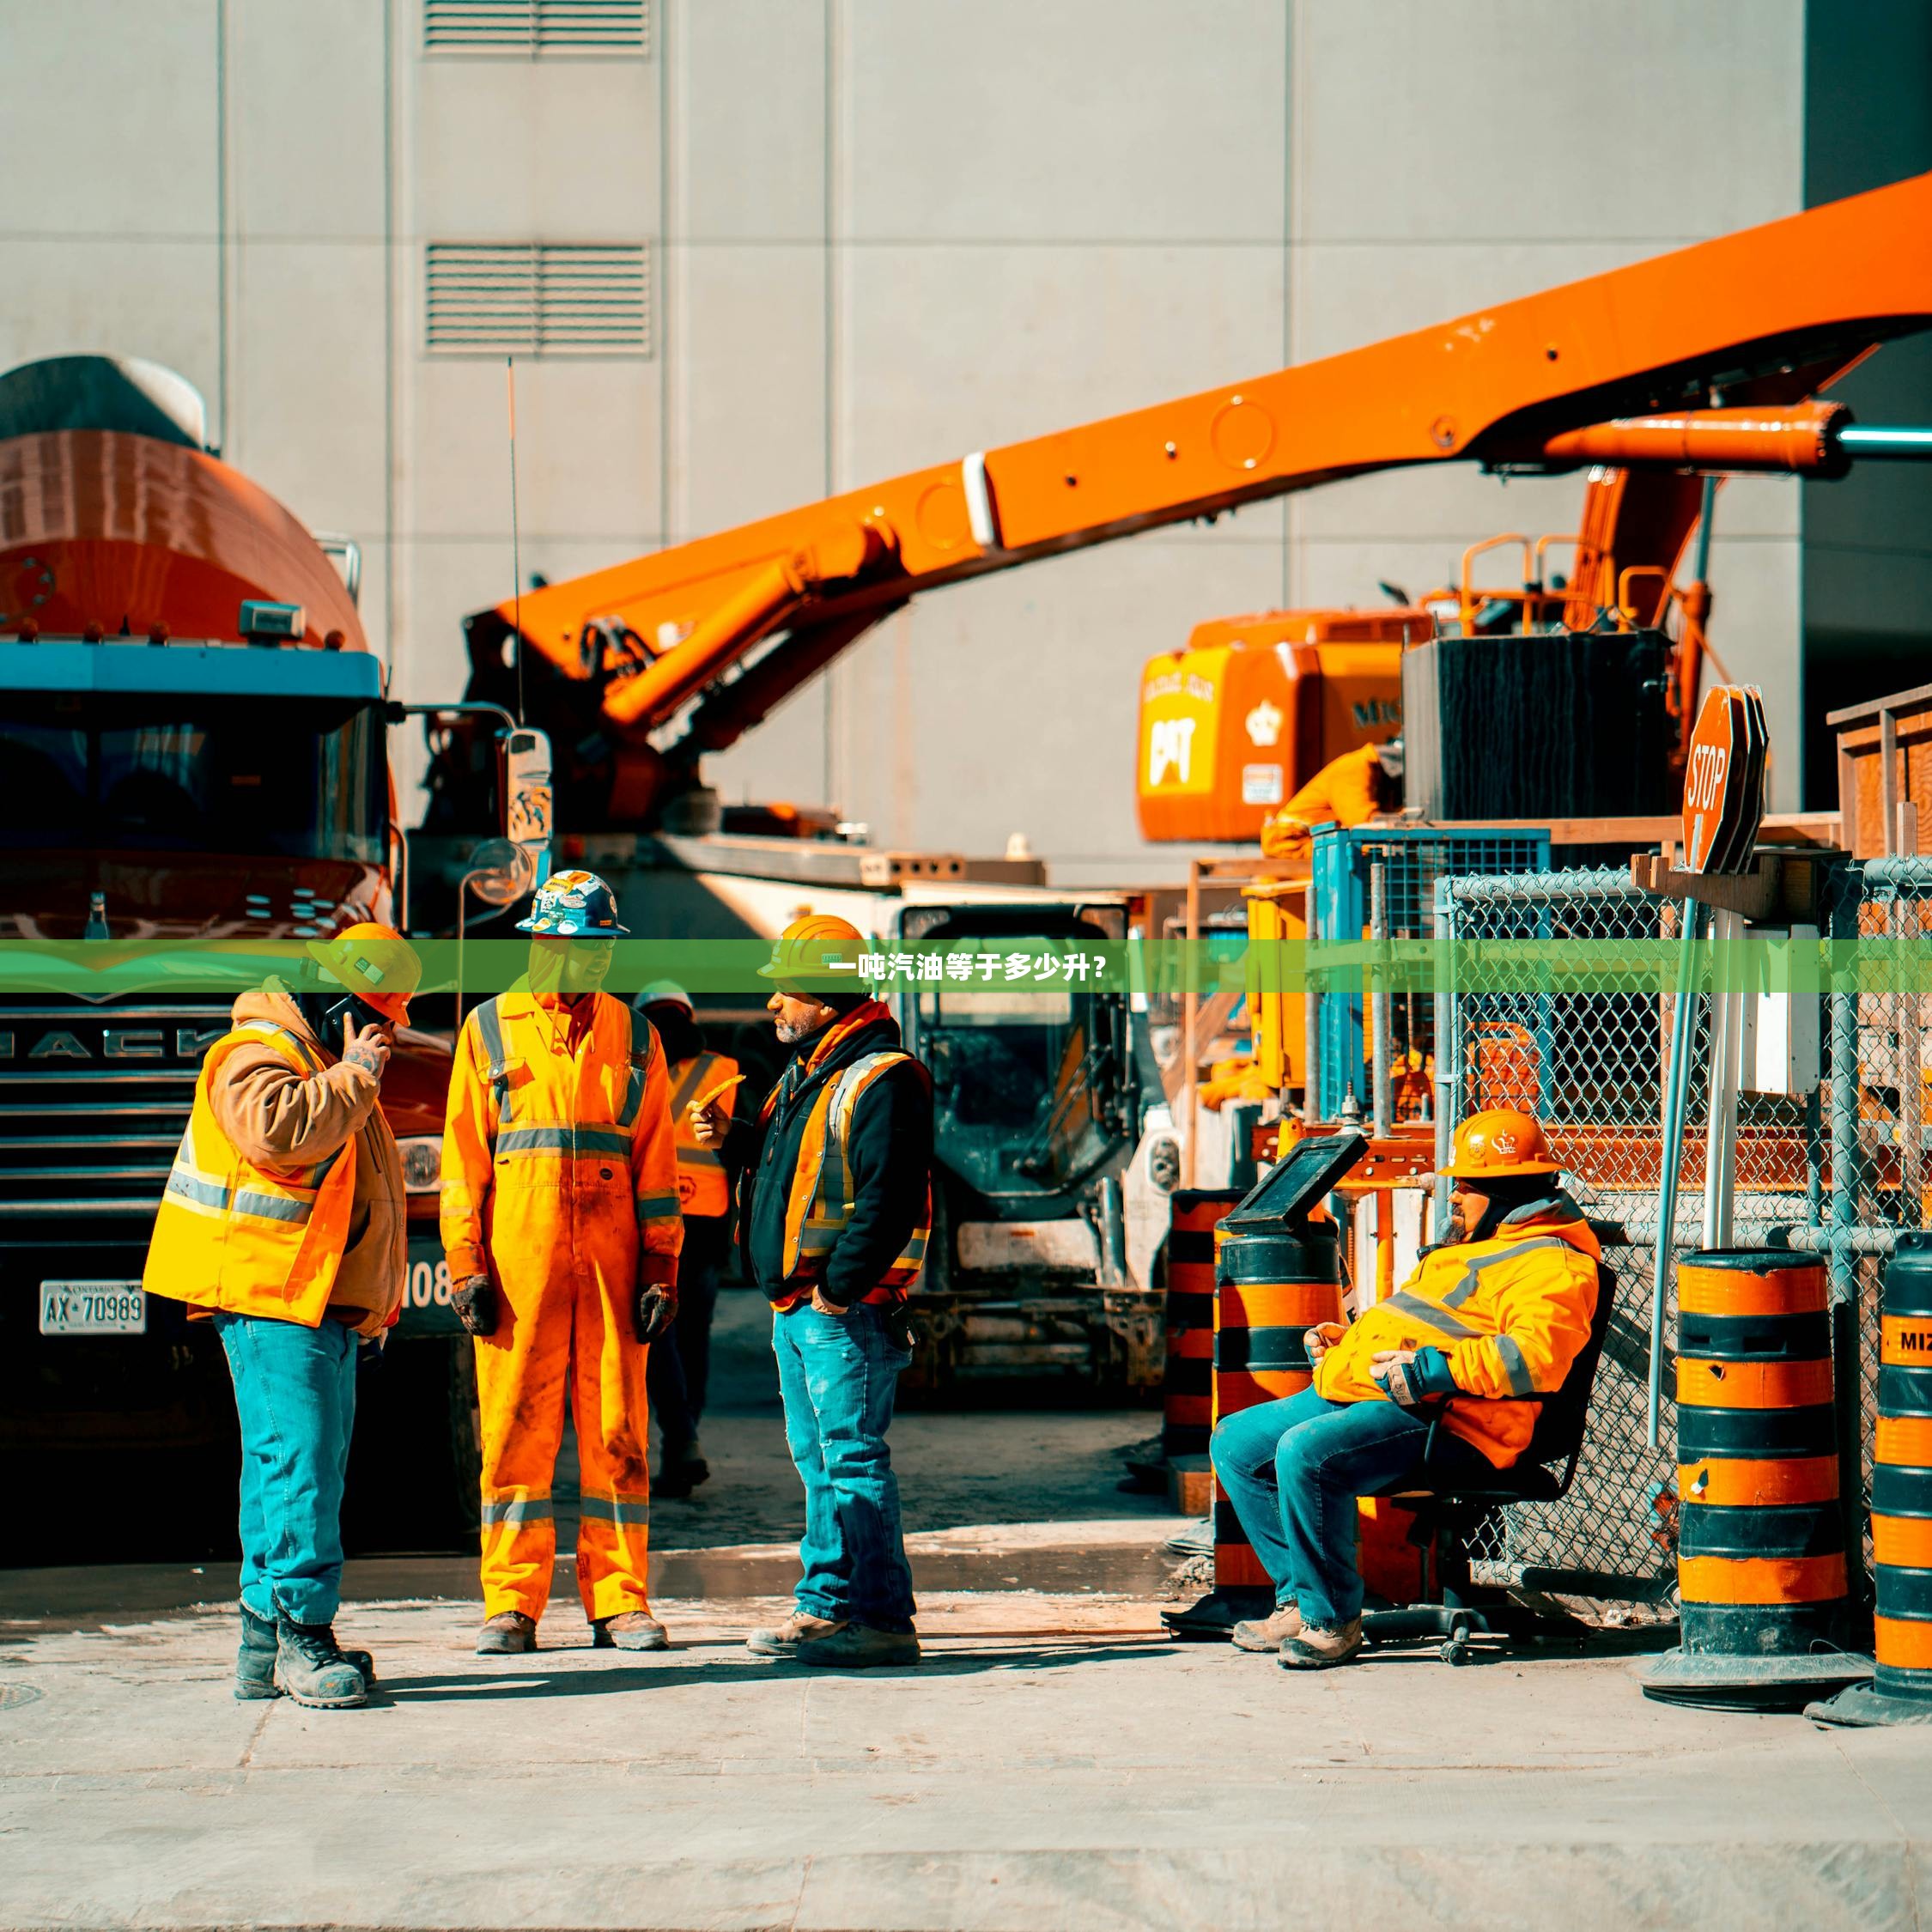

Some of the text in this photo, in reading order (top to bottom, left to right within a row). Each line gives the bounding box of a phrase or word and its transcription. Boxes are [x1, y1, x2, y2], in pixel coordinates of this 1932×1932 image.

[1688, 744, 1726, 811] STOP
[0, 1030, 232, 1058] ACK
[82, 1293, 142, 1321] 70989
